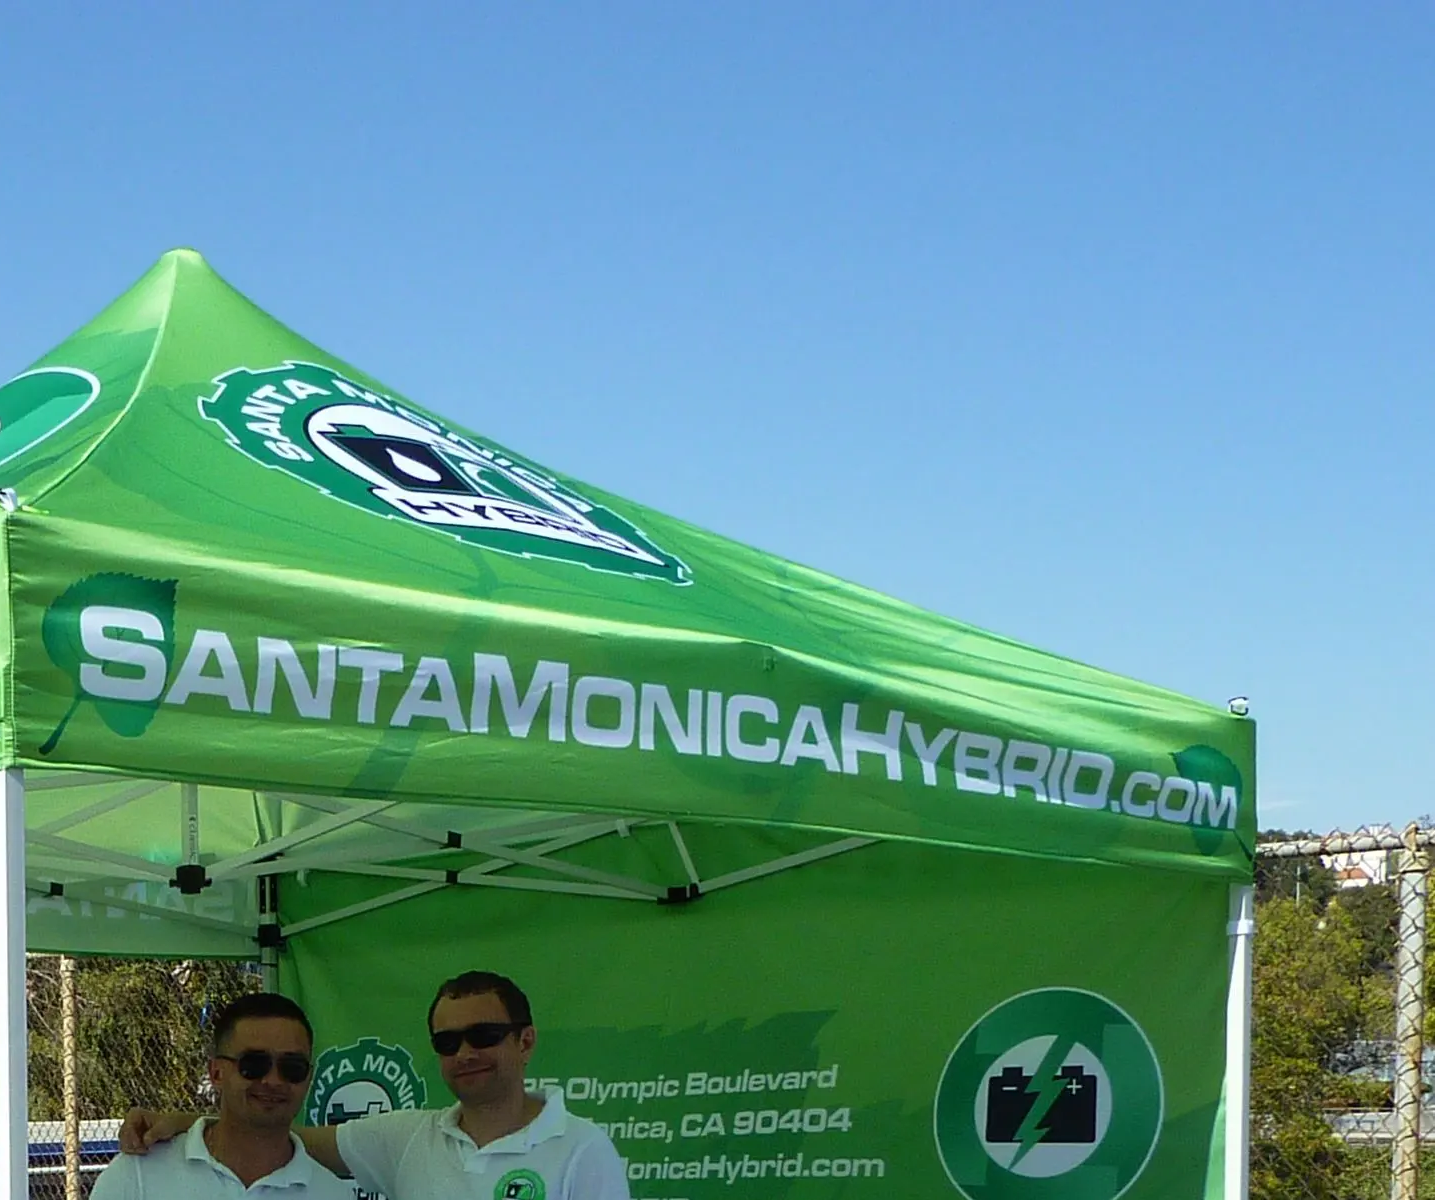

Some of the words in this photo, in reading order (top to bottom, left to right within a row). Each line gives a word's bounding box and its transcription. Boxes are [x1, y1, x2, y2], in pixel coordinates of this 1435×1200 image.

[241, 379, 332, 462] SANTA
[80, 605, 1238, 829] SANTAMONICAHYBRID.COM
[310, 1058, 356, 1127] ANTA
[362, 1053, 416, 1110] MONI
[565, 1075, 679, 1105] Olympic
[685, 1064, 839, 1096] Boulevard
[595, 1116, 674, 1144] nica,
[681, 1113, 726, 1138] CA
[732, 1107, 852, 1136] 90404
[622, 1153, 885, 1185] onicaHybrid.com
